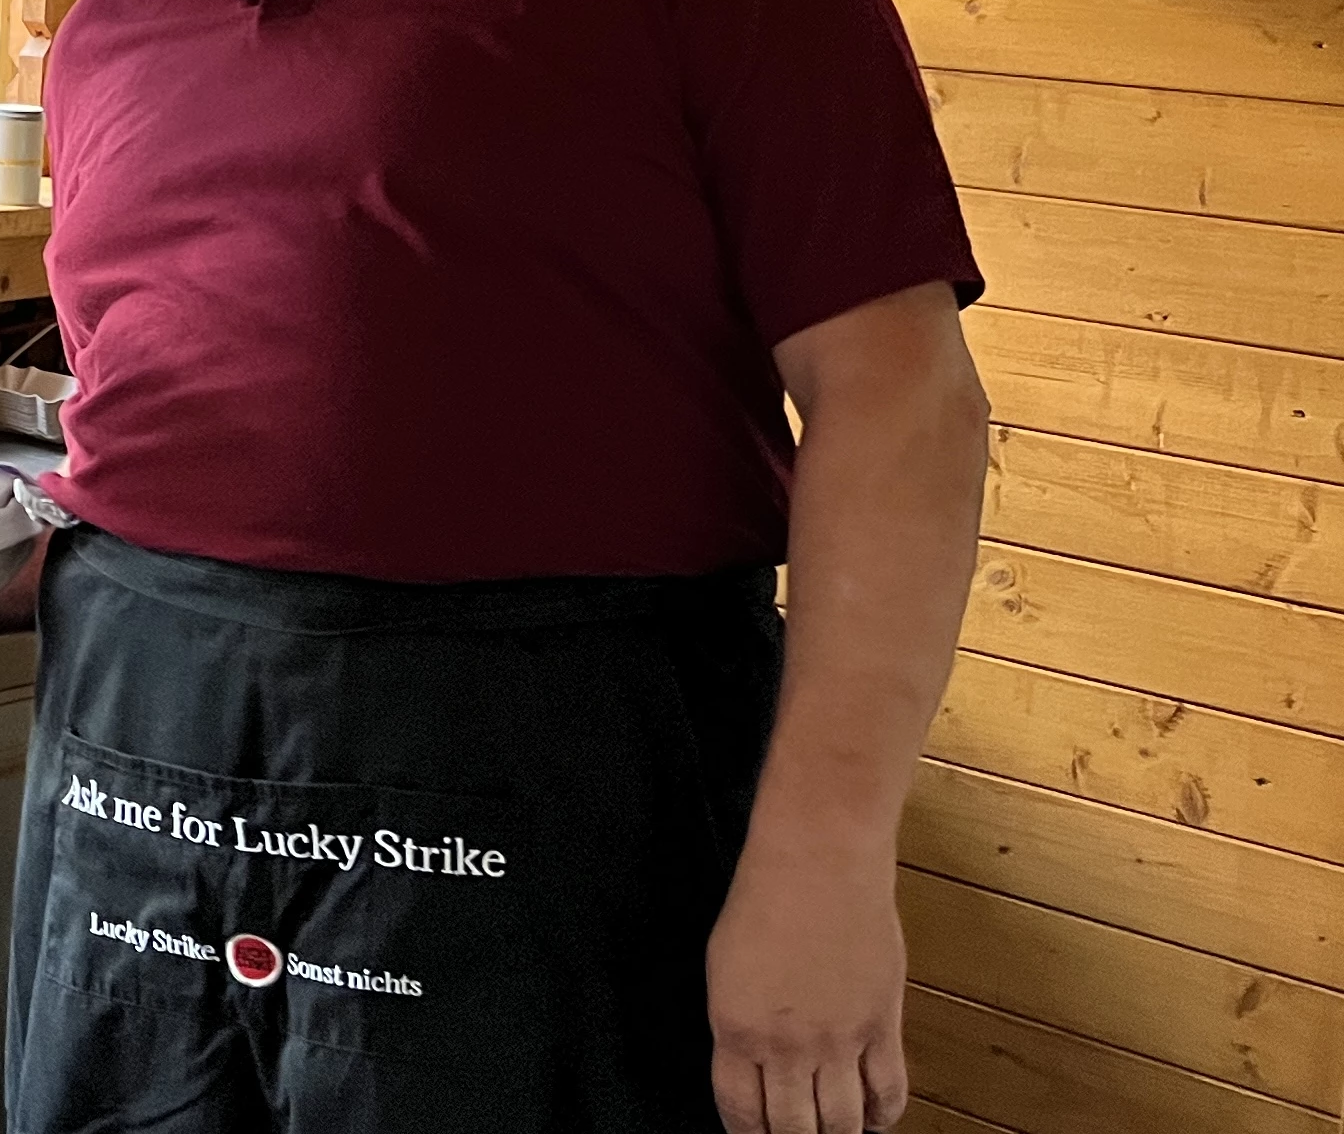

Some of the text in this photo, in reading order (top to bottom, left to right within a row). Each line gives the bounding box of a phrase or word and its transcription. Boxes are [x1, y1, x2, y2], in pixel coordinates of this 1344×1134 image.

[62, 774, 508, 878] Ask me for Lucky Strike
[89, 912, 150, 954] Lucky
[286, 952, 345, 988] Sonst
[346, 969, 424, 998] nichts
